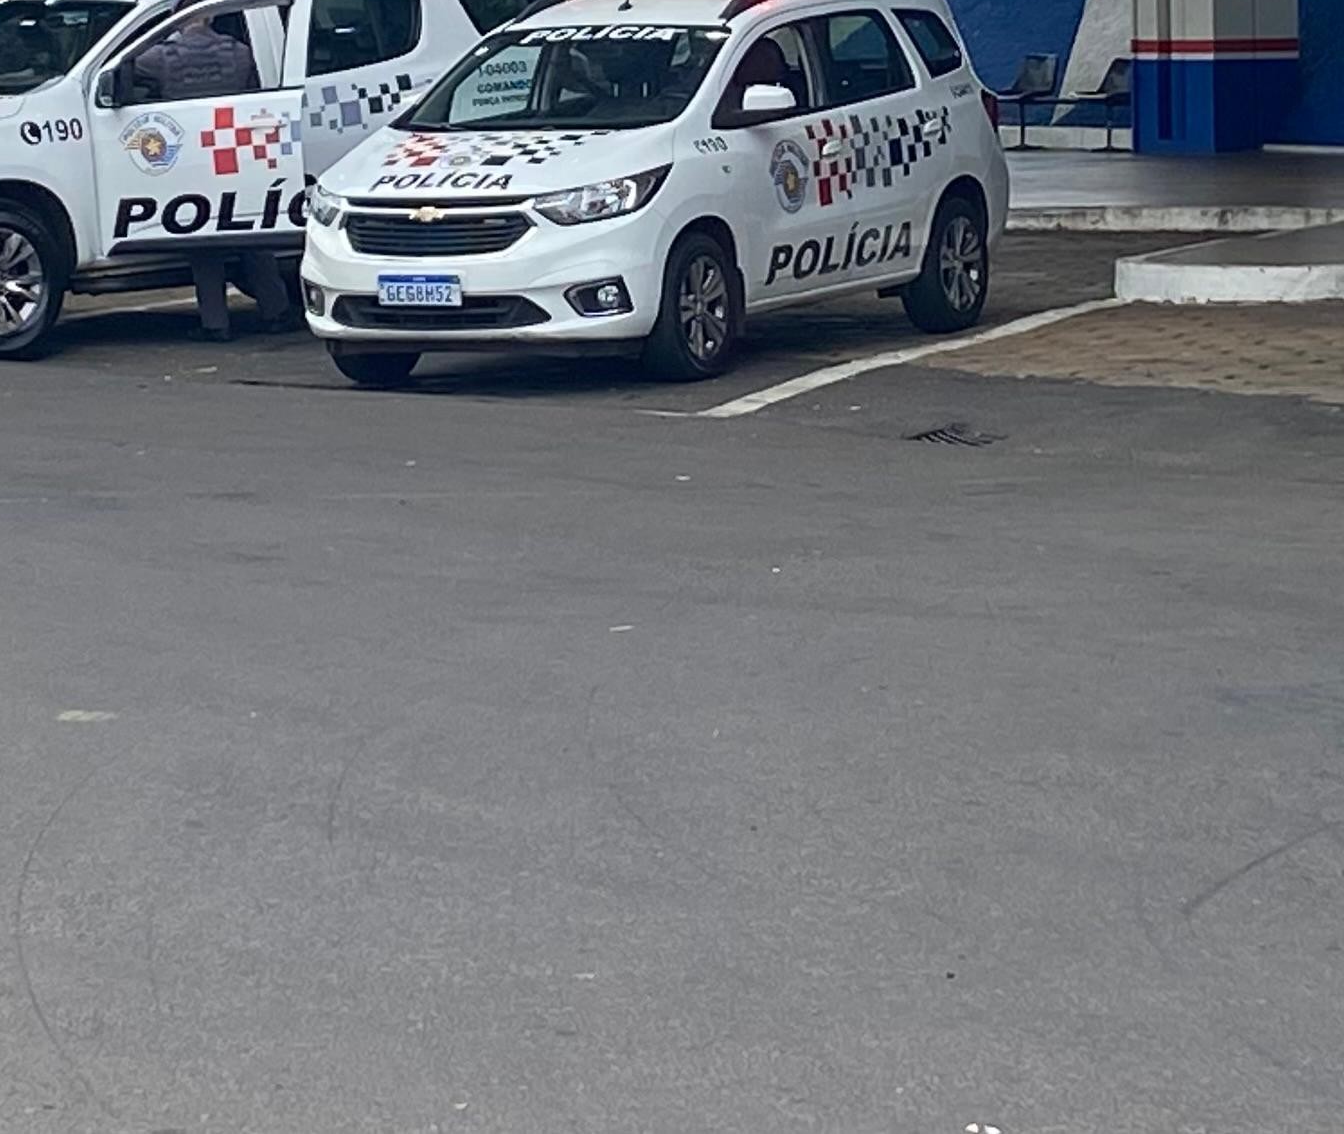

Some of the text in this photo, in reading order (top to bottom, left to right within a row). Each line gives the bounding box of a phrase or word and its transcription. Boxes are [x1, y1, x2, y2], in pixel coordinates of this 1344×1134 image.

[519, 23, 682, 45] POLÍCIA
[42, 118, 83, 142] 190
[765, 221, 912, 286] POLÍCIA
